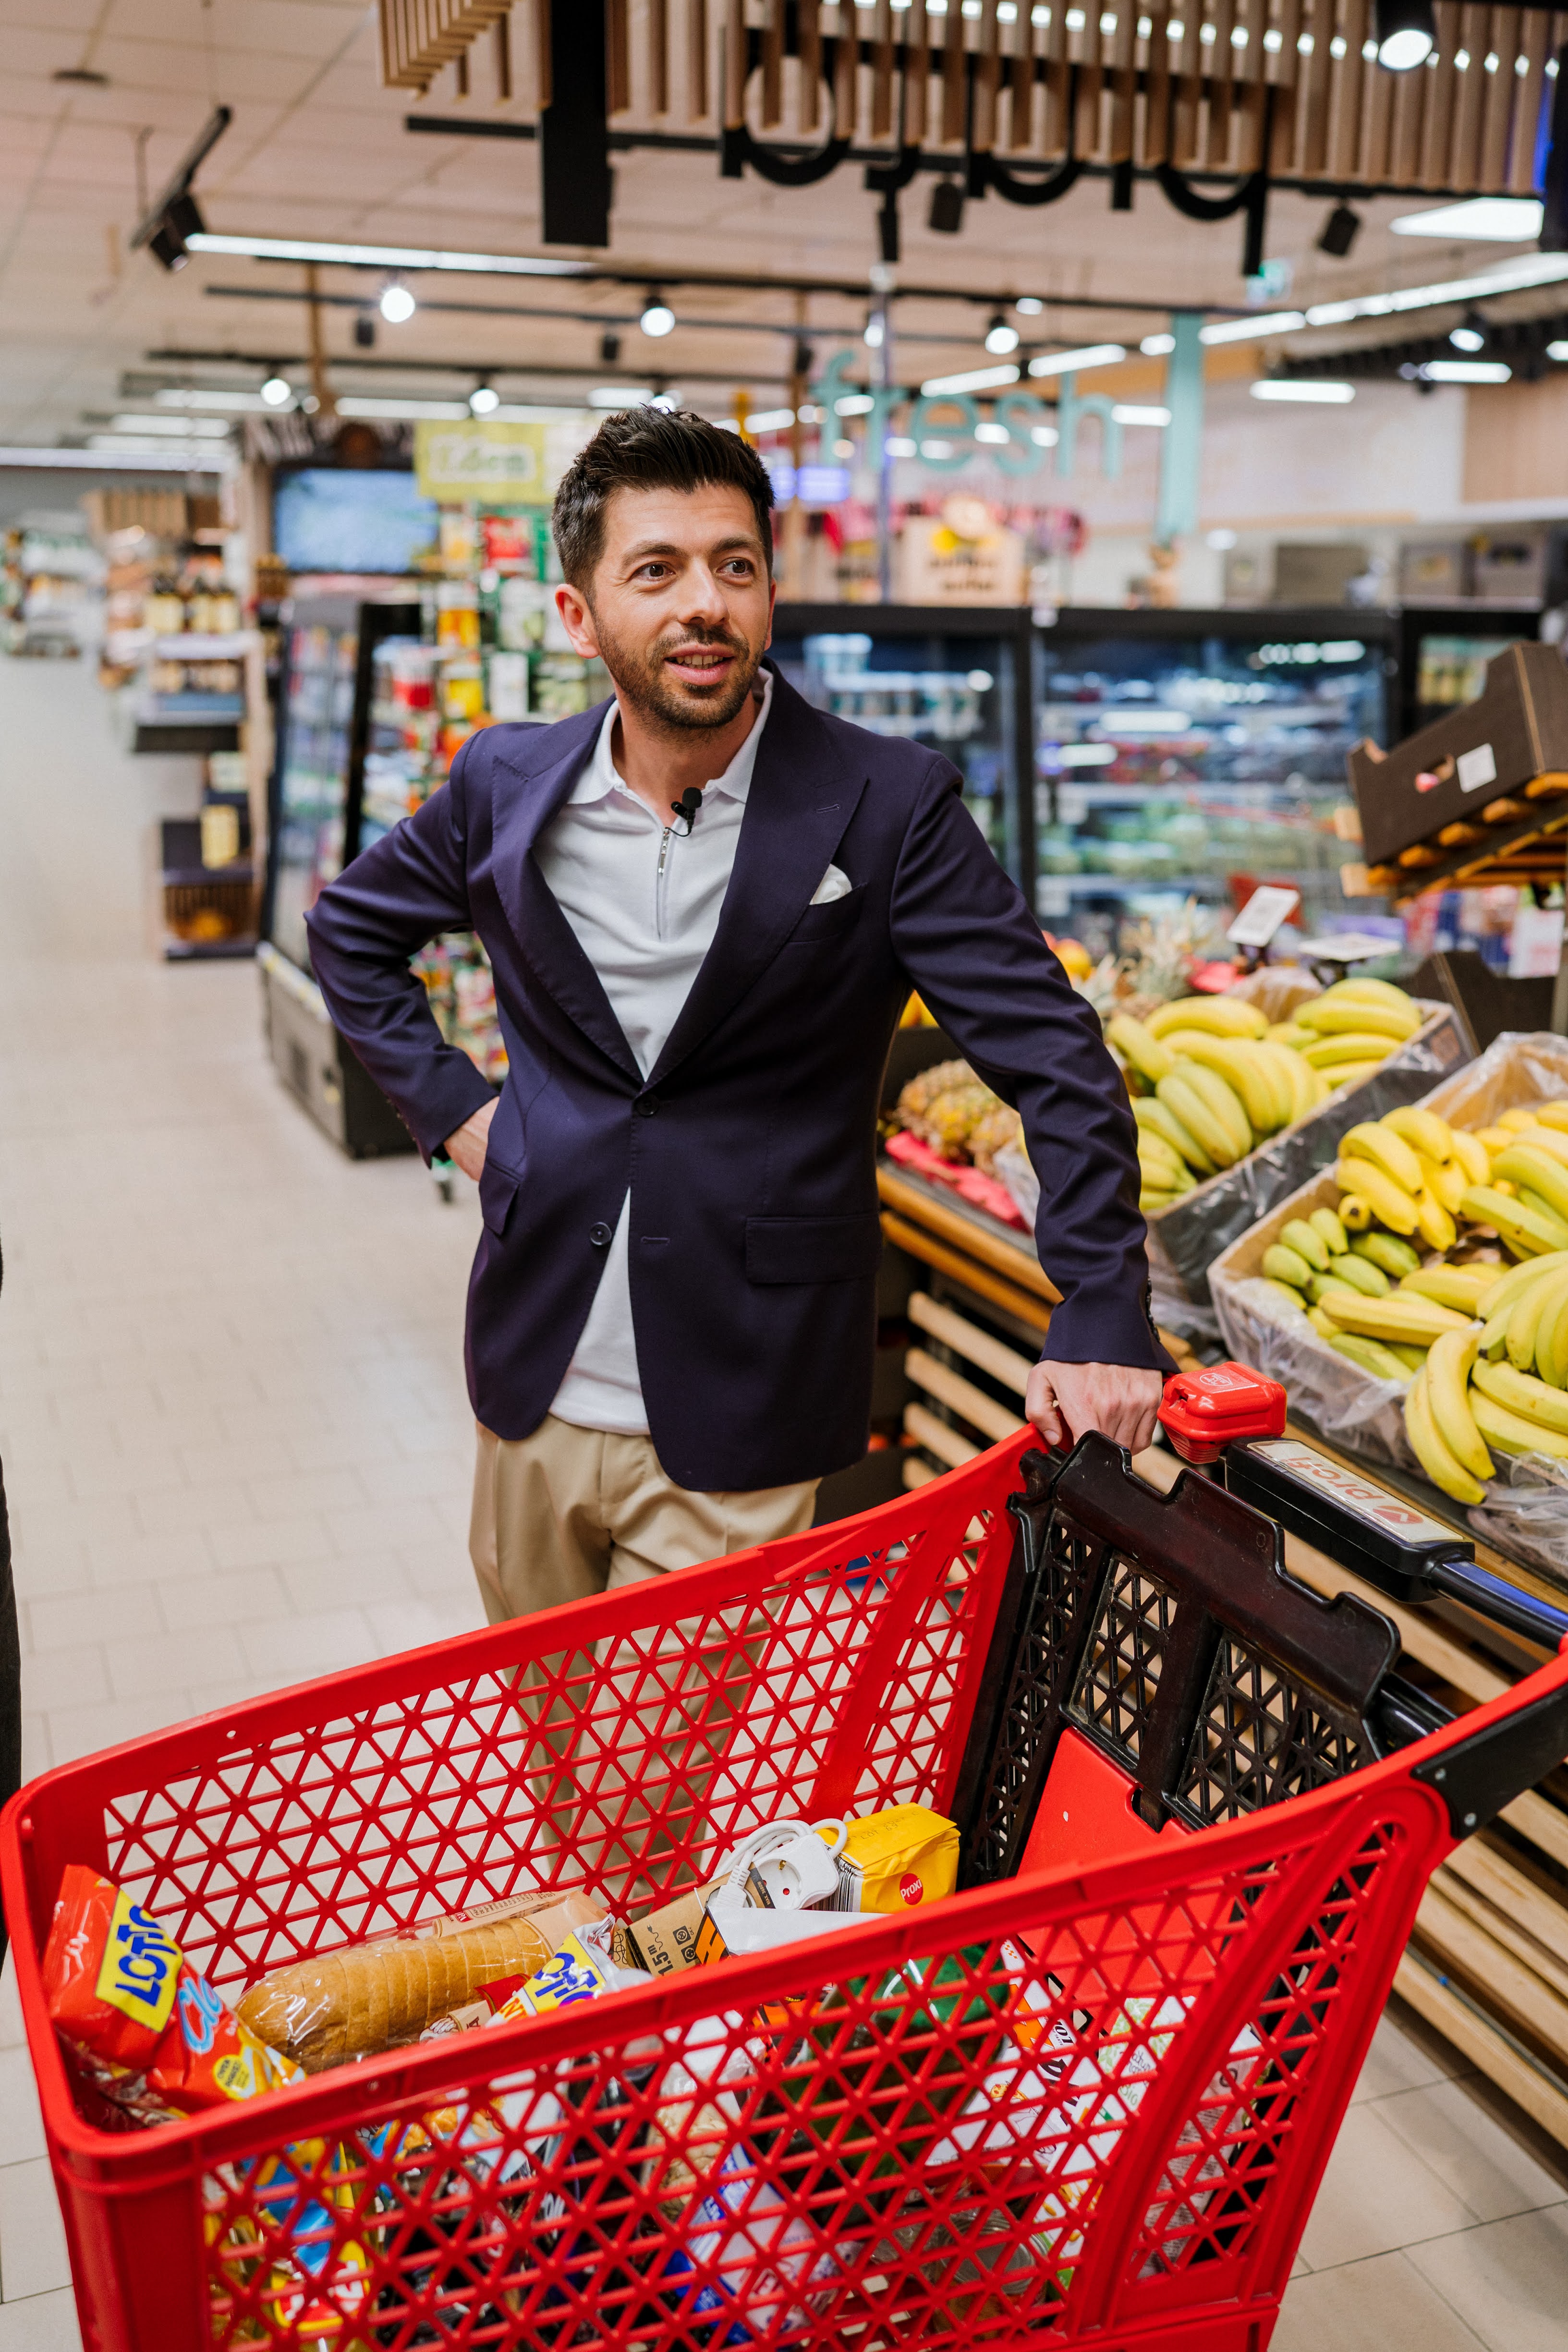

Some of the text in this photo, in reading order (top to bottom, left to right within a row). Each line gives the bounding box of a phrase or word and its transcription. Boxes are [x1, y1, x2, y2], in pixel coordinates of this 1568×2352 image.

[810, 350, 1122, 477] fresh
[1287, 1457, 1386, 1499] profi
[757, 1881, 766, 1894] 3680W
[533, 1952, 598, 2007] OTT
[1053, 2034, 1064, 2046] TASTE
